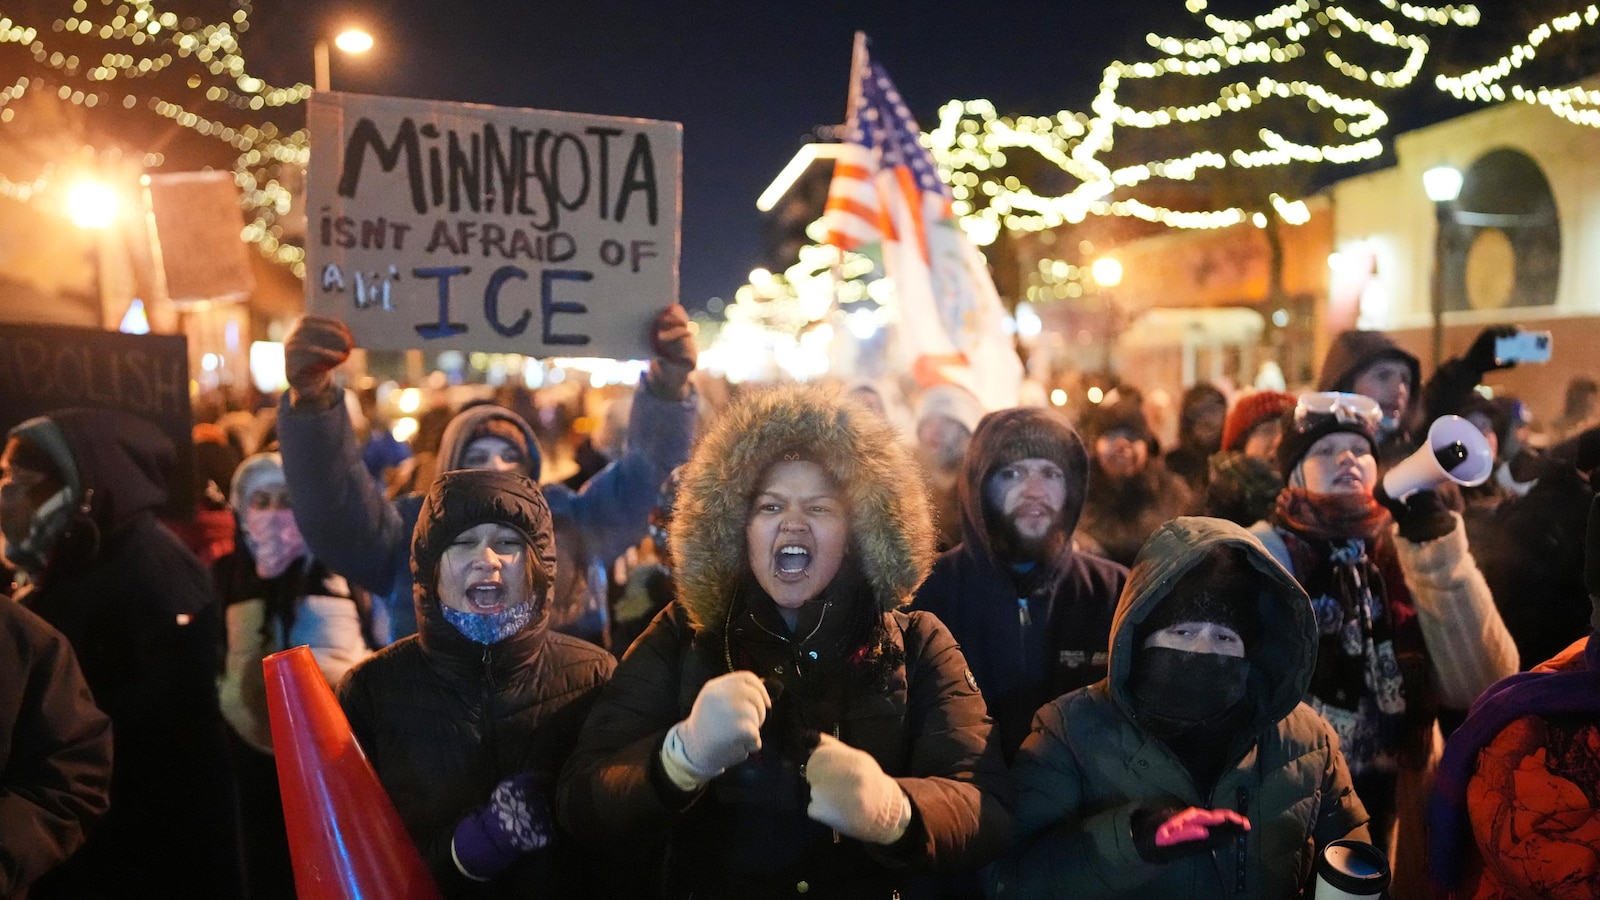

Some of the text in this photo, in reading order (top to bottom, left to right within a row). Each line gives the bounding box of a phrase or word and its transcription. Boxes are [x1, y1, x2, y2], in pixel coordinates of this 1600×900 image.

[426, 219, 577, 263] AFRAID
[599, 239, 658, 273] OF
[321, 262, 346, 293] A
[412, 264, 594, 346] ICE
